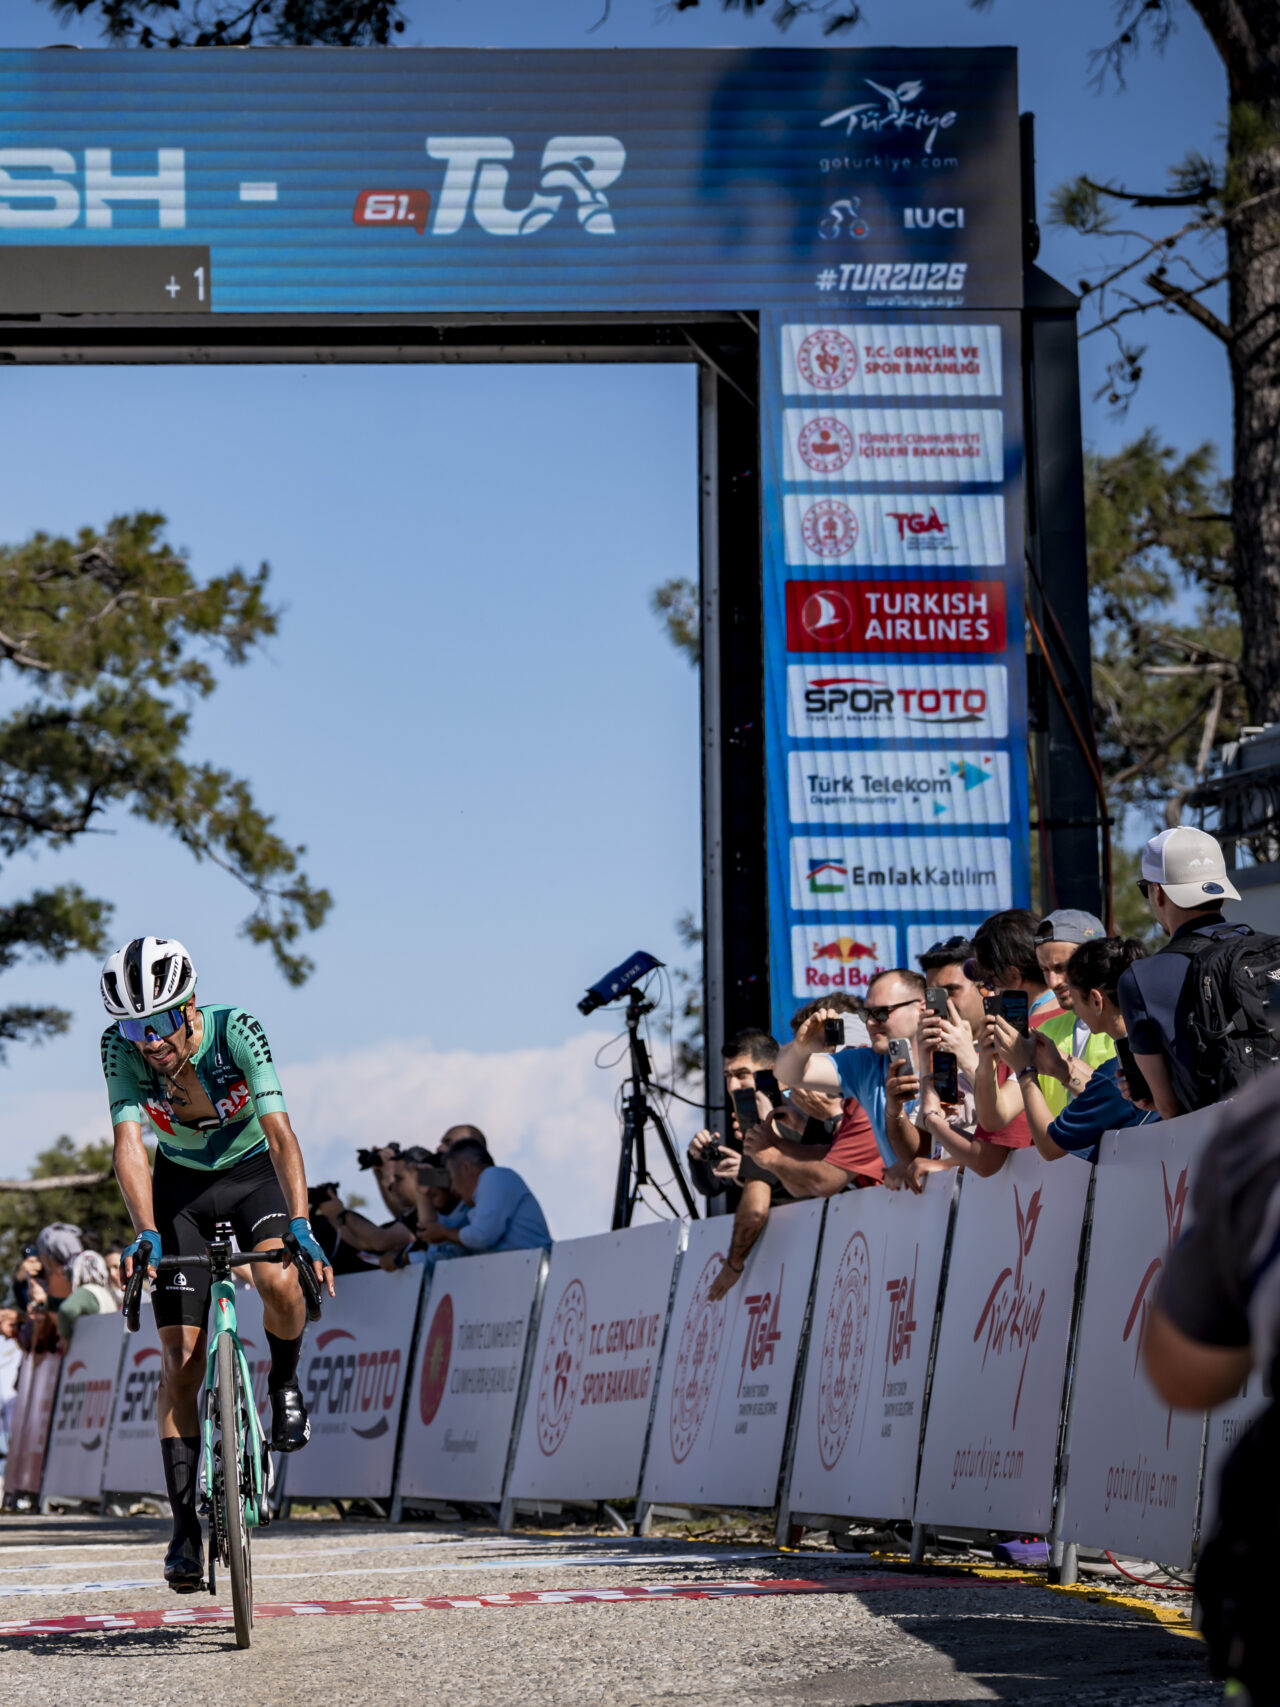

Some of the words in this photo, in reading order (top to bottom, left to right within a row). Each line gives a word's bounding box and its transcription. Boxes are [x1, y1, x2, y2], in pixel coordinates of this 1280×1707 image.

[820, 103, 957, 154] Türkiye
[820, 155, 959, 172] goturkiye.com
[363, 194, 416, 220] 61.
[426, 136, 626, 234] TUR
[913, 207, 965, 229] UCI
[193, 266, 207, 301] 1
[815, 263, 968, 291] #TUR2026
[864, 346, 891, 358] T.C.
[893, 344, 956, 360] GENÇLİK
[960, 346, 979, 358] VE
[865, 362, 901, 375] SPOR
[905, 360, 980, 375] BAKANLIĞI
[912, 444, 980, 458] BAKANLIĞI
[885, 506, 949, 541] TGA
[864, 592, 988, 616] TURKISH
[864, 618, 990, 641] AIRLINES
[807, 775, 854, 793] Türk
[861, 775, 952, 793] Telekom
[230, 1024, 264, 1067] PHARMA
[236, 1012, 273, 1064] KERN
[738, 1278, 784, 1390] TGA
[883, 1260, 919, 1388] TGA
[580, 1371, 606, 1406] SPOR
[950, 1437, 1025, 1491] goturkiye.com
[1104, 1455, 1178, 1518] goturkiye.com
